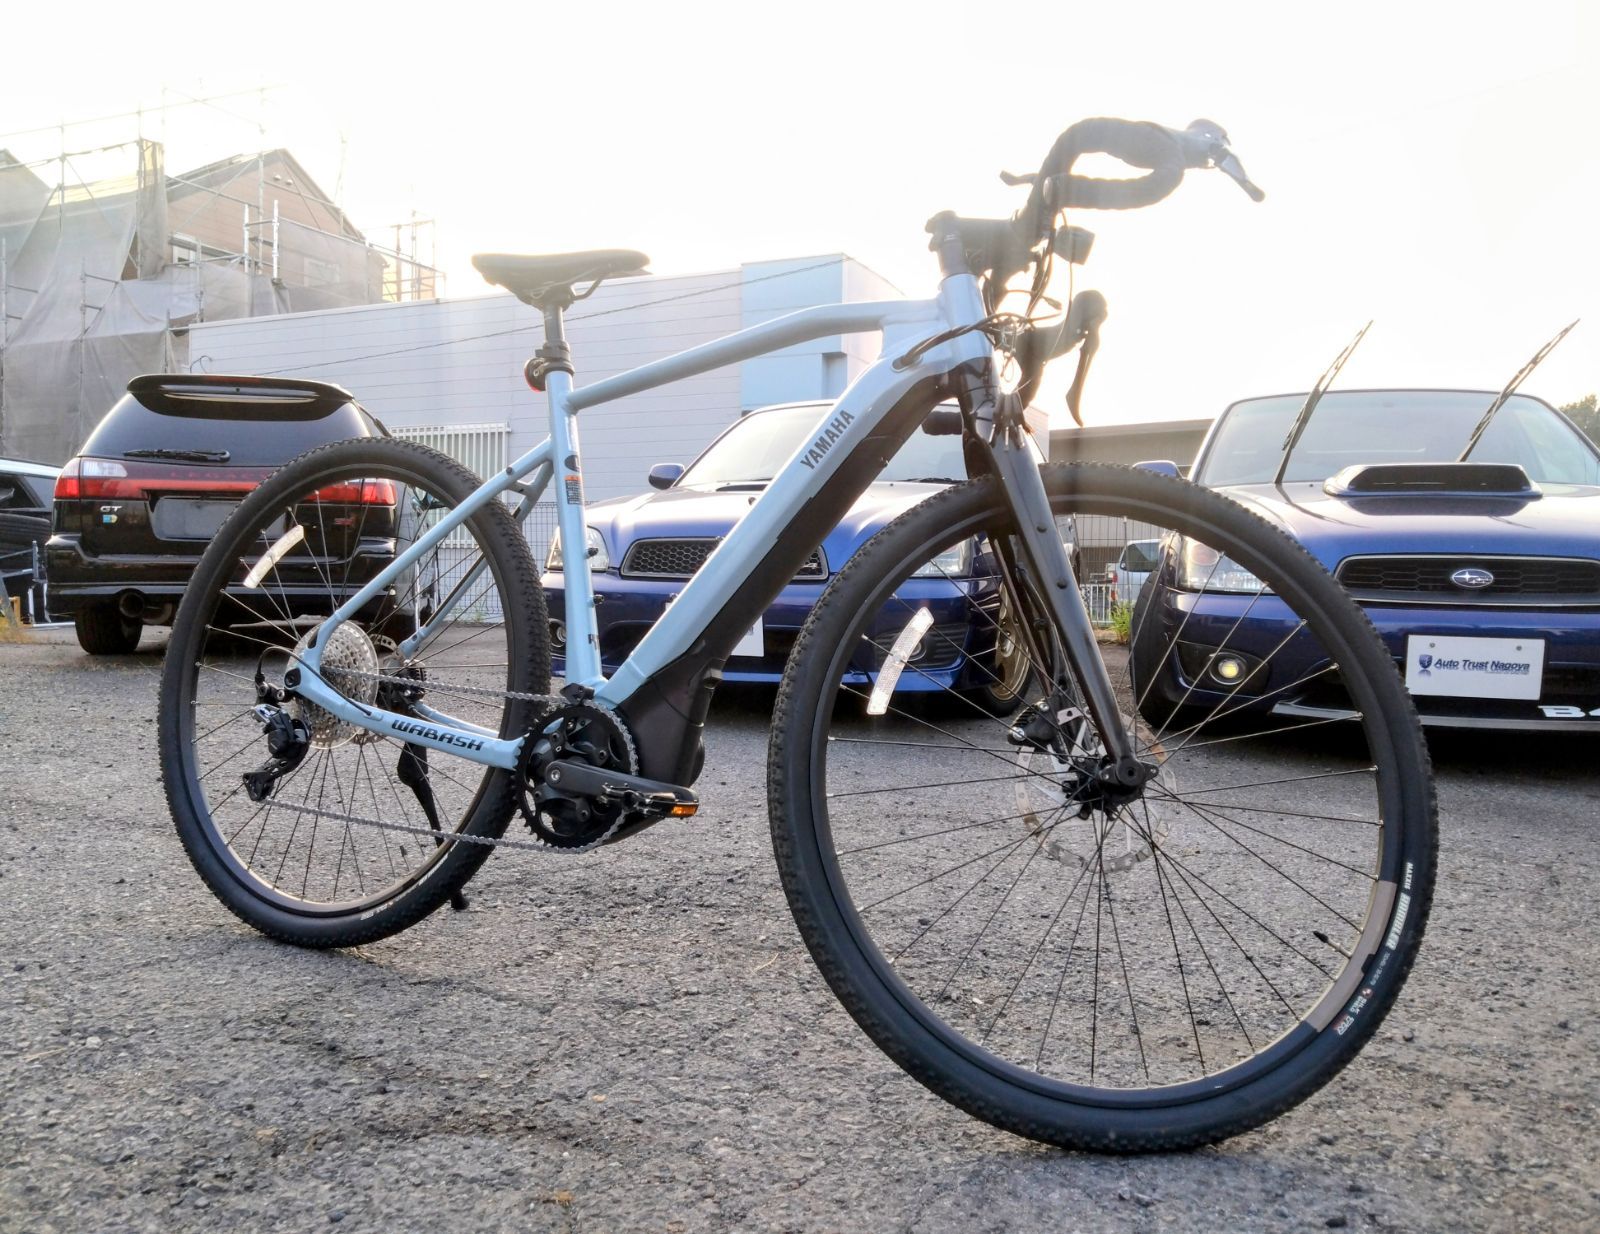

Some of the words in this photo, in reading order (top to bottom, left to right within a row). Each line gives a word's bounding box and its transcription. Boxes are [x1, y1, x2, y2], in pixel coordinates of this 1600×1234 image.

[800, 410, 855, 470] YAMAHA
[100, 505, 122, 513] GT
[1433, 658, 1459, 669] Auto
[1462, 659, 1489, 670] Trust
[391, 719, 485, 751] WABASH
[1404, 862, 1414, 890] MAXXIS
